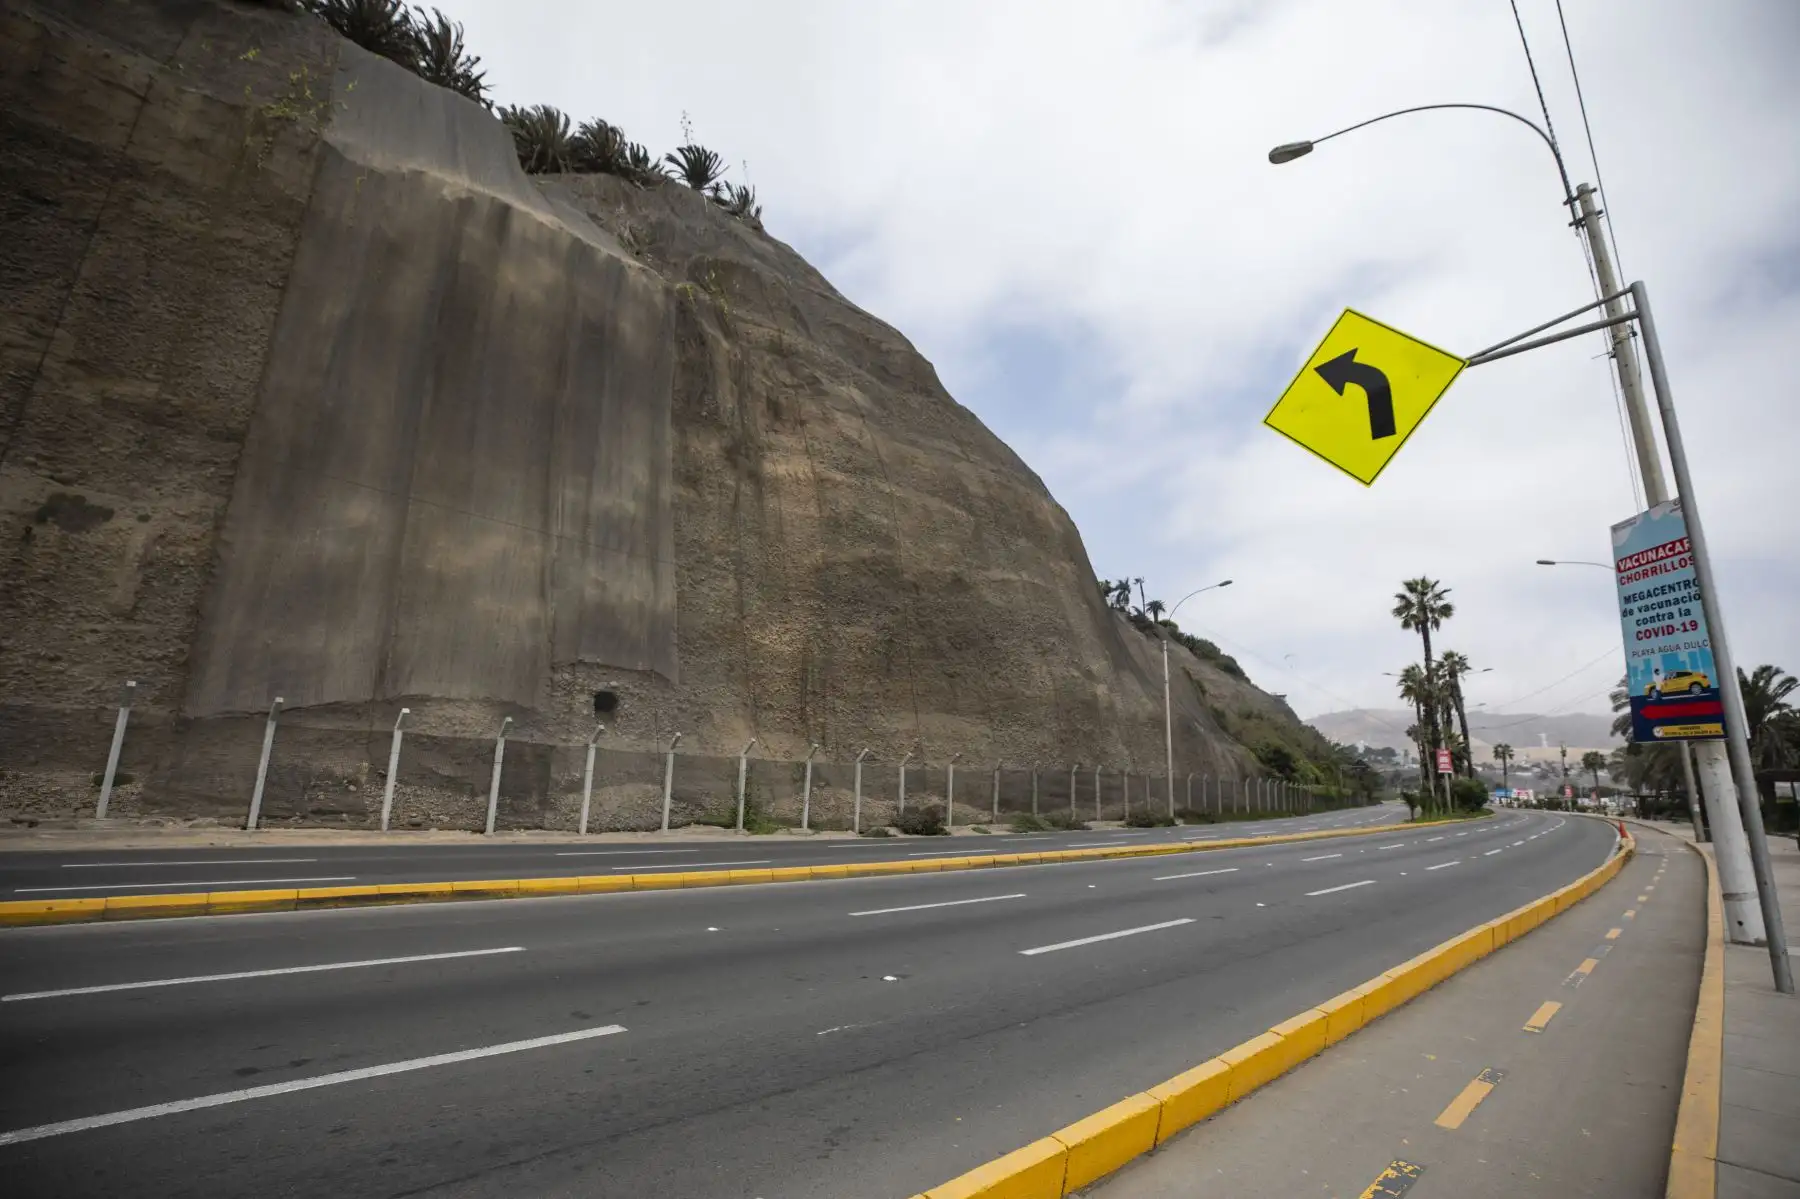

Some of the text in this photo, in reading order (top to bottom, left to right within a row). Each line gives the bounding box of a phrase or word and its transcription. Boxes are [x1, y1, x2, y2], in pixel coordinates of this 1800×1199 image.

[1620, 556, 1695, 585] CHORRILLOS
[1622, 590, 1701, 618] de vacunació
[1635, 607, 1692, 626] contra la
[1635, 620, 1699, 641] COVID-19
[1632, 639, 1709, 658] PLAYA AGUA DULC
